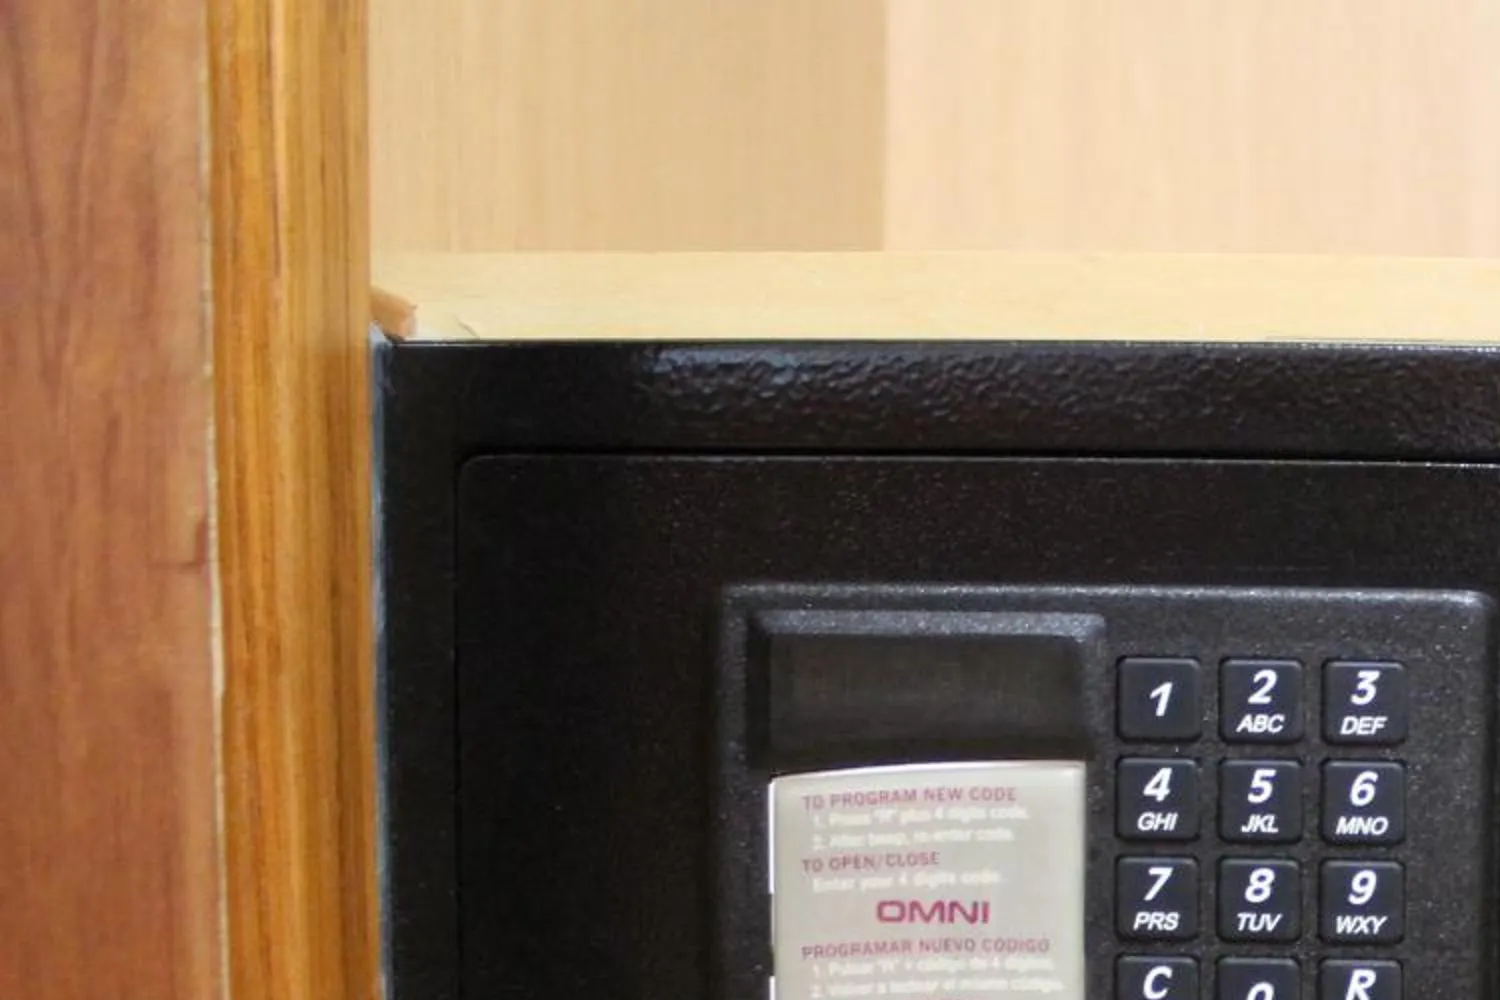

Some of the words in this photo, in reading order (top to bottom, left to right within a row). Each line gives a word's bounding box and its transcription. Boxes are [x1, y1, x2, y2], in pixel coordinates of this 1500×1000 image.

[1149, 681, 1174, 717] 1
[1246, 669, 1278, 705] 2
[1350, 669, 1382, 707] 3
[1235, 713, 1286, 735] ABC
[1339, 715, 1389, 736] DEF
[1142, 766, 1173, 803] 4
[1246, 768, 1277, 805] 5
[1349, 770, 1379, 807] 6
[802, 795, 825, 811] TO
[830, 789, 917, 808] PROGRAM
[923, 787, 964, 802] NEW
[968, 786, 1018, 802] CODE
[1136, 811, 1179, 832] GHI
[1240, 813, 1279, 834] JKL
[1334, 815, 1390, 837] MNO
[801, 858, 824, 873] TO
[828, 851, 941, 872] OPEN/CLOSE
[1143, 866, 1174, 902] 7
[1244, 867, 1275, 904] 8
[1347, 869, 1378, 906] 9
[876, 899, 990, 924] OMNI
[1132, 910, 1181, 932] PRS
[1236, 911, 1283, 933] TUV
[1335, 914, 1389, 935] WXY
[801, 939, 914, 960] PROGRAMAR
[918, 938, 976, 954] NUEVO
[1142, 964, 1173, 1000] C
